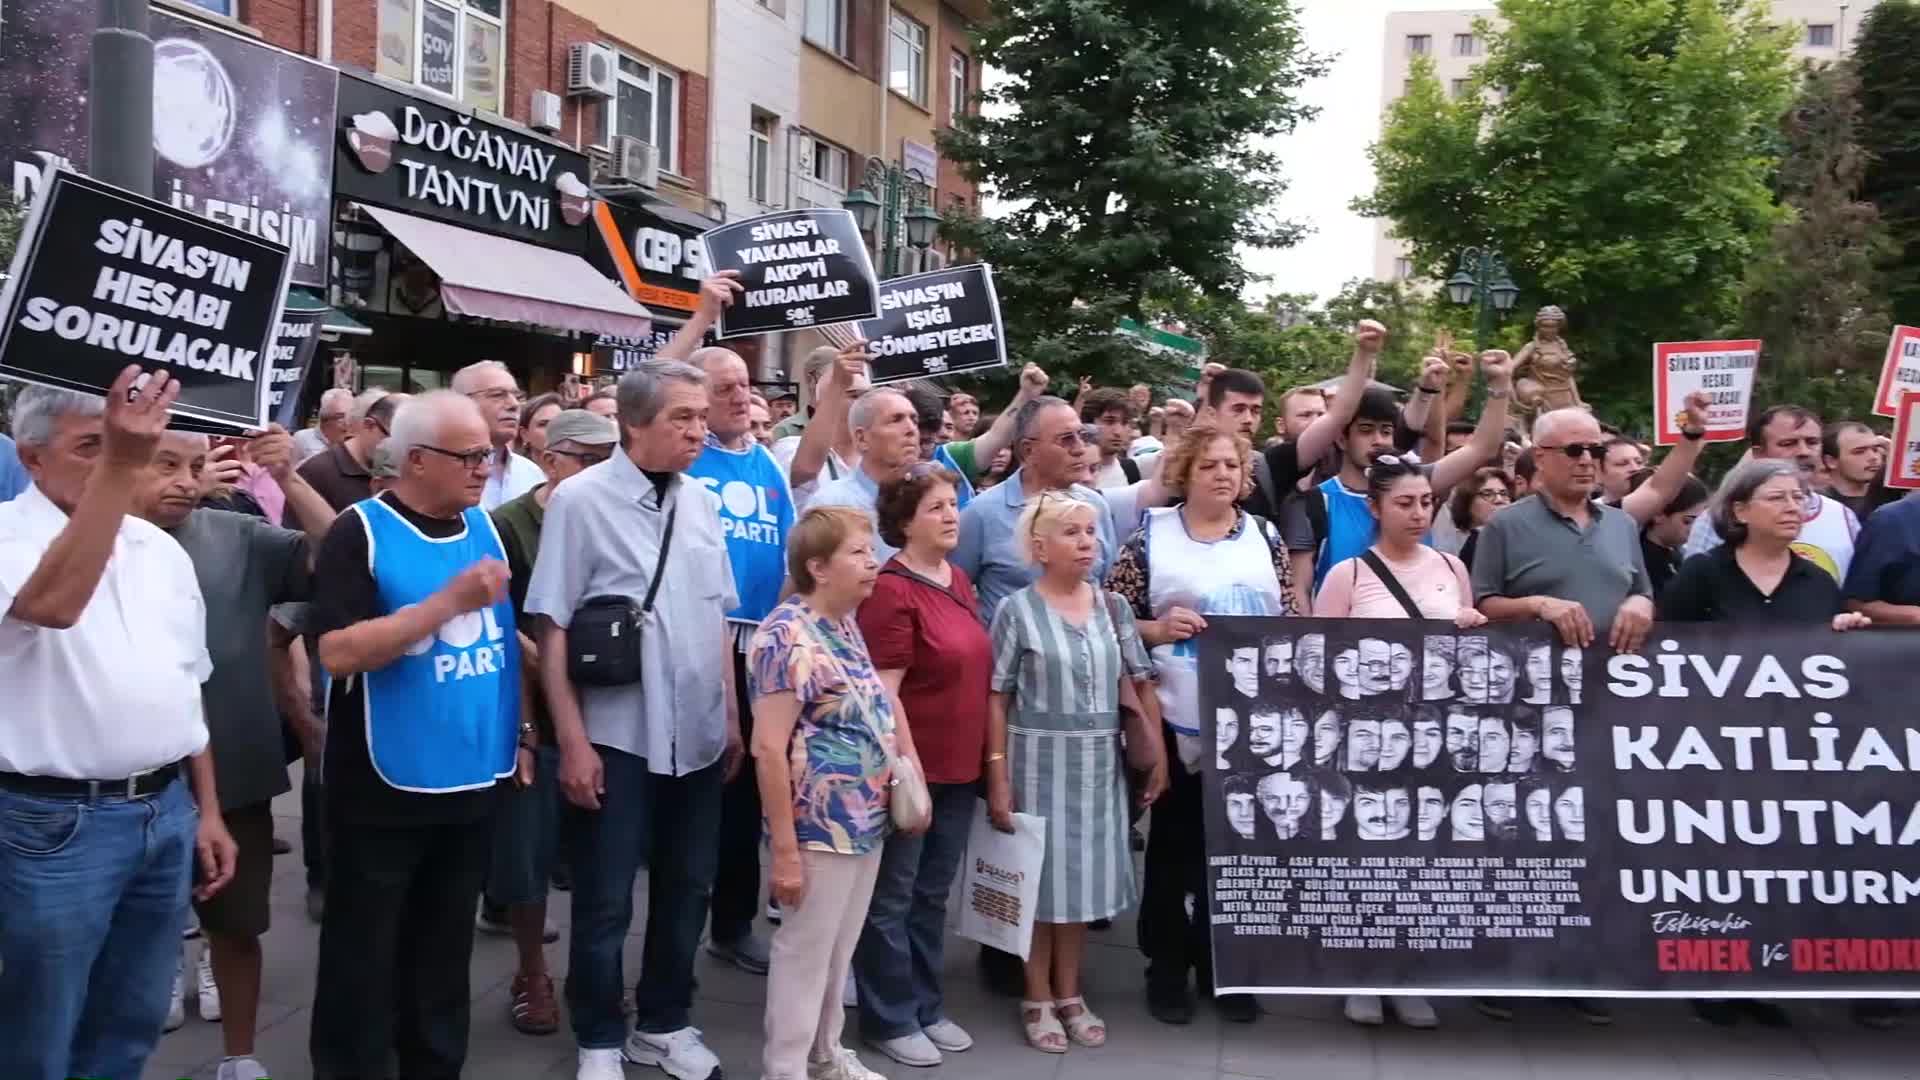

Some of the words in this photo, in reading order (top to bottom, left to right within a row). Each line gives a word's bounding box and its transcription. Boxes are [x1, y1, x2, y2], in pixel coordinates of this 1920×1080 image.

[423, 32, 453, 62] çay
[401, 106, 556, 182] DOĞANAY
[636, 227, 682, 274] CEP
[736, 239, 841, 265] YAKANLAR
[763, 257, 828, 284] AKP'Yİ
[93, 266, 232, 331] HESABI
[745, 280, 850, 308] KURANLAR
[905, 304, 952, 330] IŞIĞI
[19, 296, 259, 381] SORULACAK
[869, 323, 996, 359] SÖNMEYECEK
[1607, 639, 1849, 699] SİVAS
[1619, 869, 1920, 904] UNUTTURM
[1651, 910, 1752, 935] Eskişehir
[1657, 939, 1752, 971] EMEK
[1761, 943, 1789, 967] Ve
